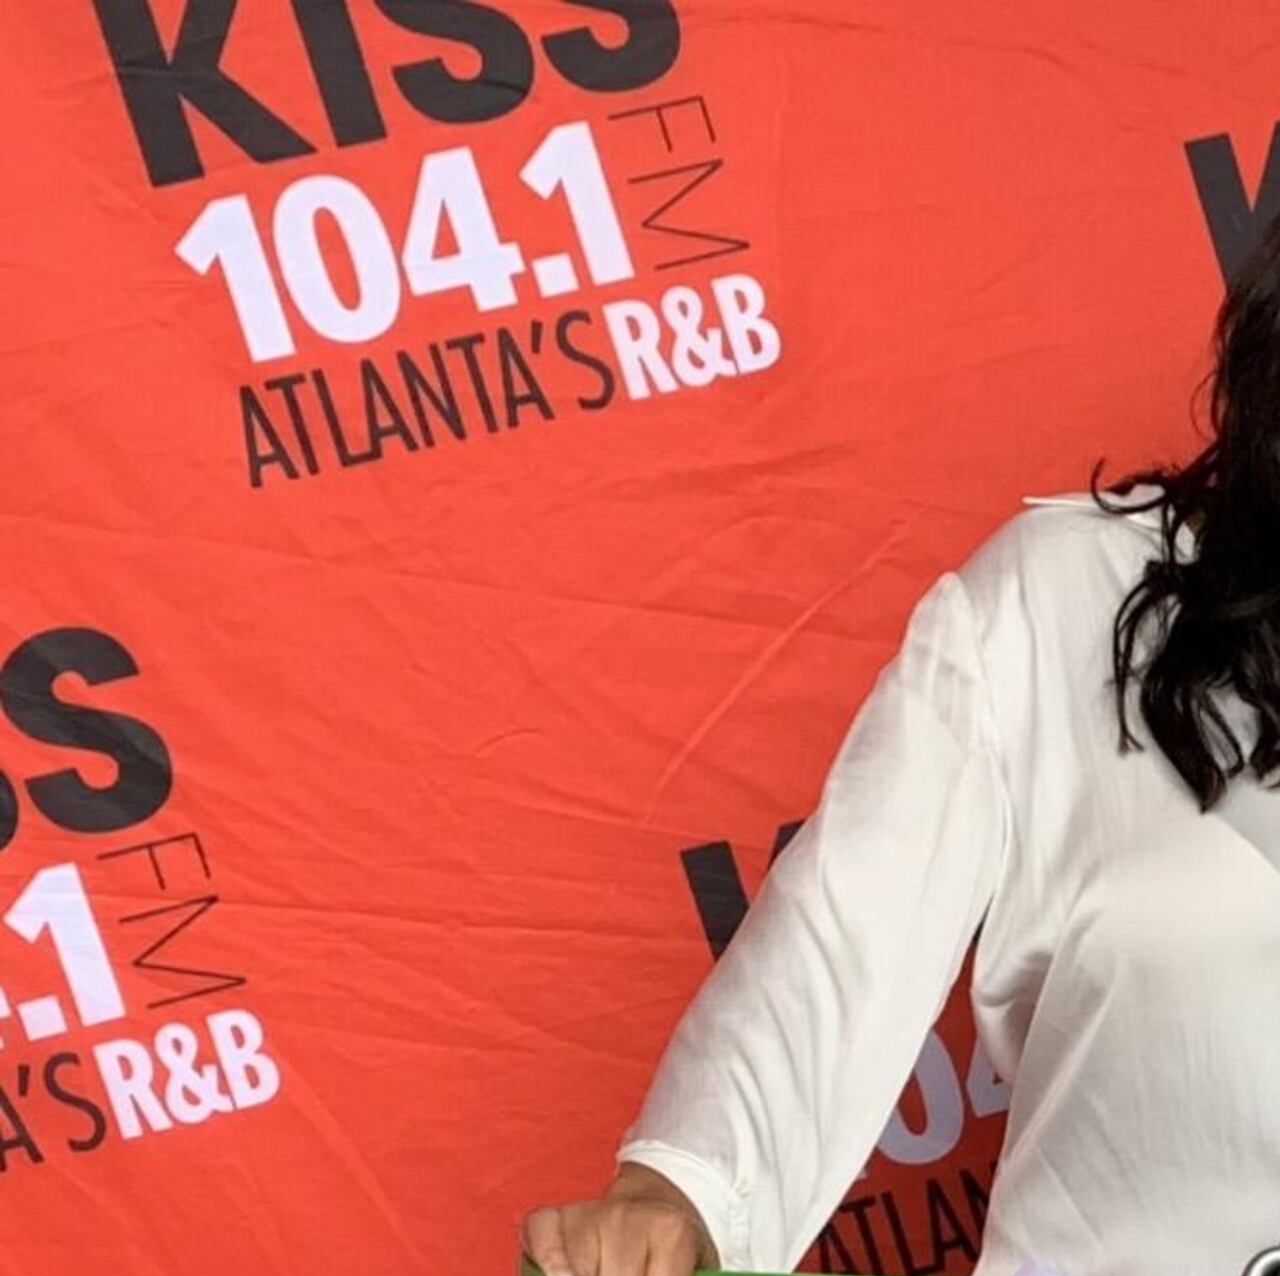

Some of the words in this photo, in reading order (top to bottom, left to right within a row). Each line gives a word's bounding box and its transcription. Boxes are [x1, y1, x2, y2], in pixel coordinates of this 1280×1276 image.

[174, 121, 635, 363] 104.1
[607, 96, 750, 271] FM
[239, 311, 615, 488] ATLANTA'S
[603, 274, 781, 400] R&B
[96, 833, 247, 1010] FM
[94, 1009, 281, 1141] R&B
